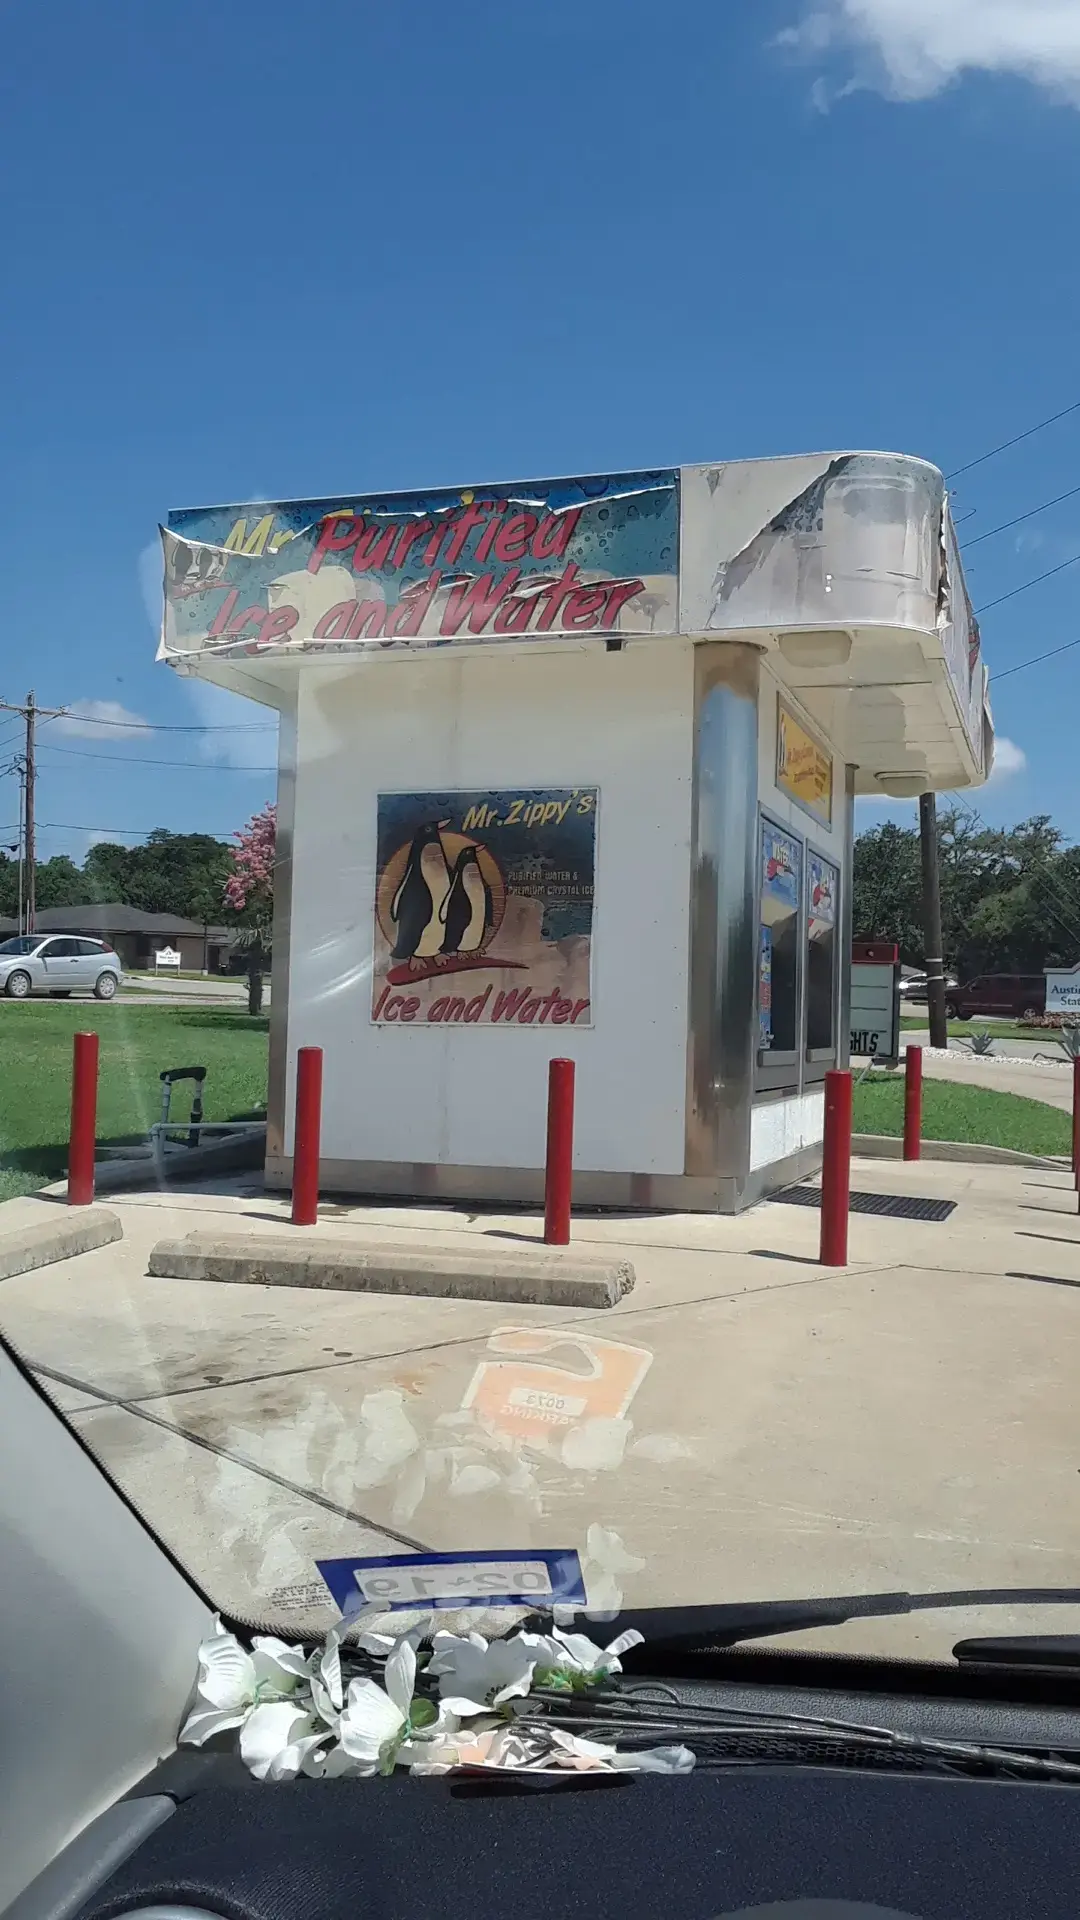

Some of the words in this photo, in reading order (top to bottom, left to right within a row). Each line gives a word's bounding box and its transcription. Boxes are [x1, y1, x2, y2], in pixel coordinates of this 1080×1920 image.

[307, 497, 583, 576] Purified
[313, 568, 443, 640] and
[439, 562, 647, 637] Water
[545, 871, 571, 881] WATER
[547, 885, 580, 896] CRYSTAL
[582, 885, 594, 896] ICE
[371, 985, 421, 1023] Ice
[427, 983, 494, 1024] and
[491, 985, 591, 1025] Water
